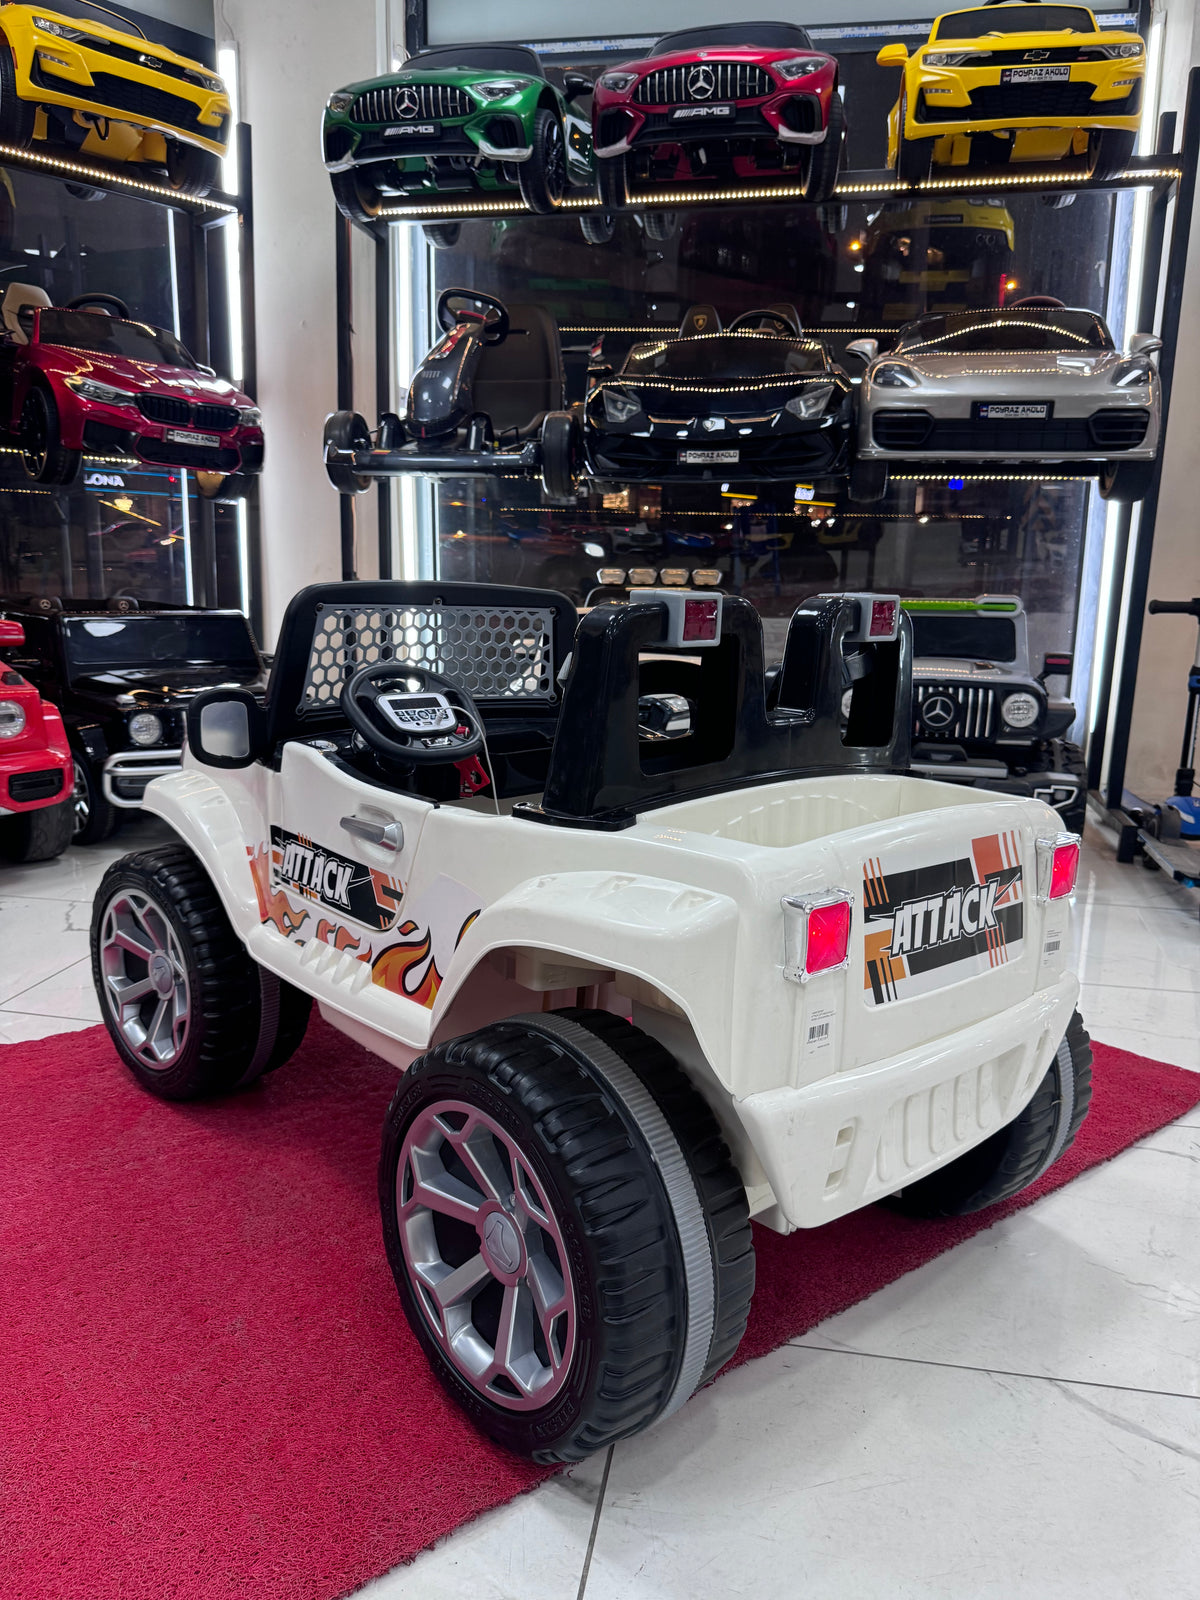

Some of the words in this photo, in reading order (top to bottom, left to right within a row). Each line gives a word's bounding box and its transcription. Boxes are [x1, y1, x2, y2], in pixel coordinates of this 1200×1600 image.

[1012, 68, 1044, 77] POYRAZ
[690, 106, 730, 117] AMG
[398, 125, 435, 135] AMG
[989, 405, 1019, 414] POYRAZ
[281, 840, 354, 908] ATTACK
[889, 878, 1003, 958] ATTACK
